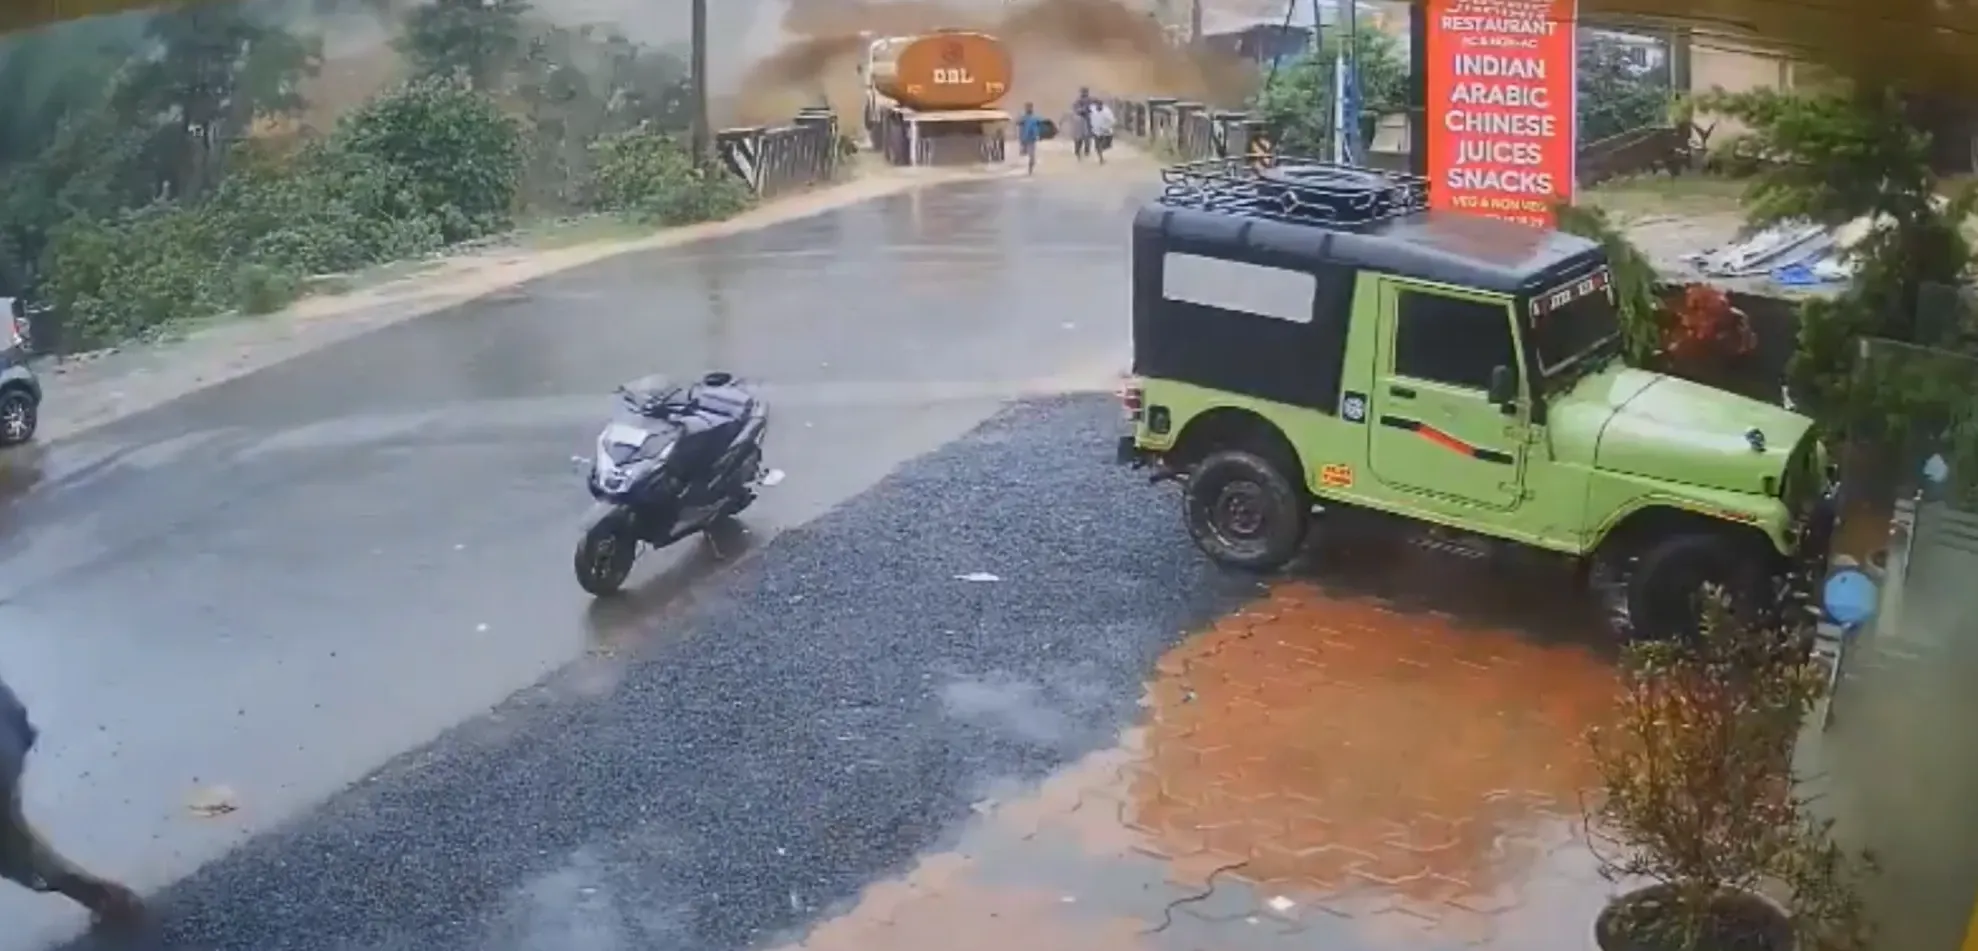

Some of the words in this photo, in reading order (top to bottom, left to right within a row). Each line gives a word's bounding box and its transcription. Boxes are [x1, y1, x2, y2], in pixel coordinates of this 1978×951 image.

[1441, 15, 1557, 35] RESTAURANT
[1454, 53, 1546, 79] INDIAN
[1451, 81, 1550, 108] ARABIC
[1444, 110, 1557, 137] CHINESE
[1456, 139, 1543, 165] JUICES
[1447, 167, 1553, 194] SNACKS
[1452, 196, 1477, 208] VEG
[1480, 198, 1490, 208] &
[1491, 198, 1519, 209] NON
[1520, 200, 1547, 213] VEG
